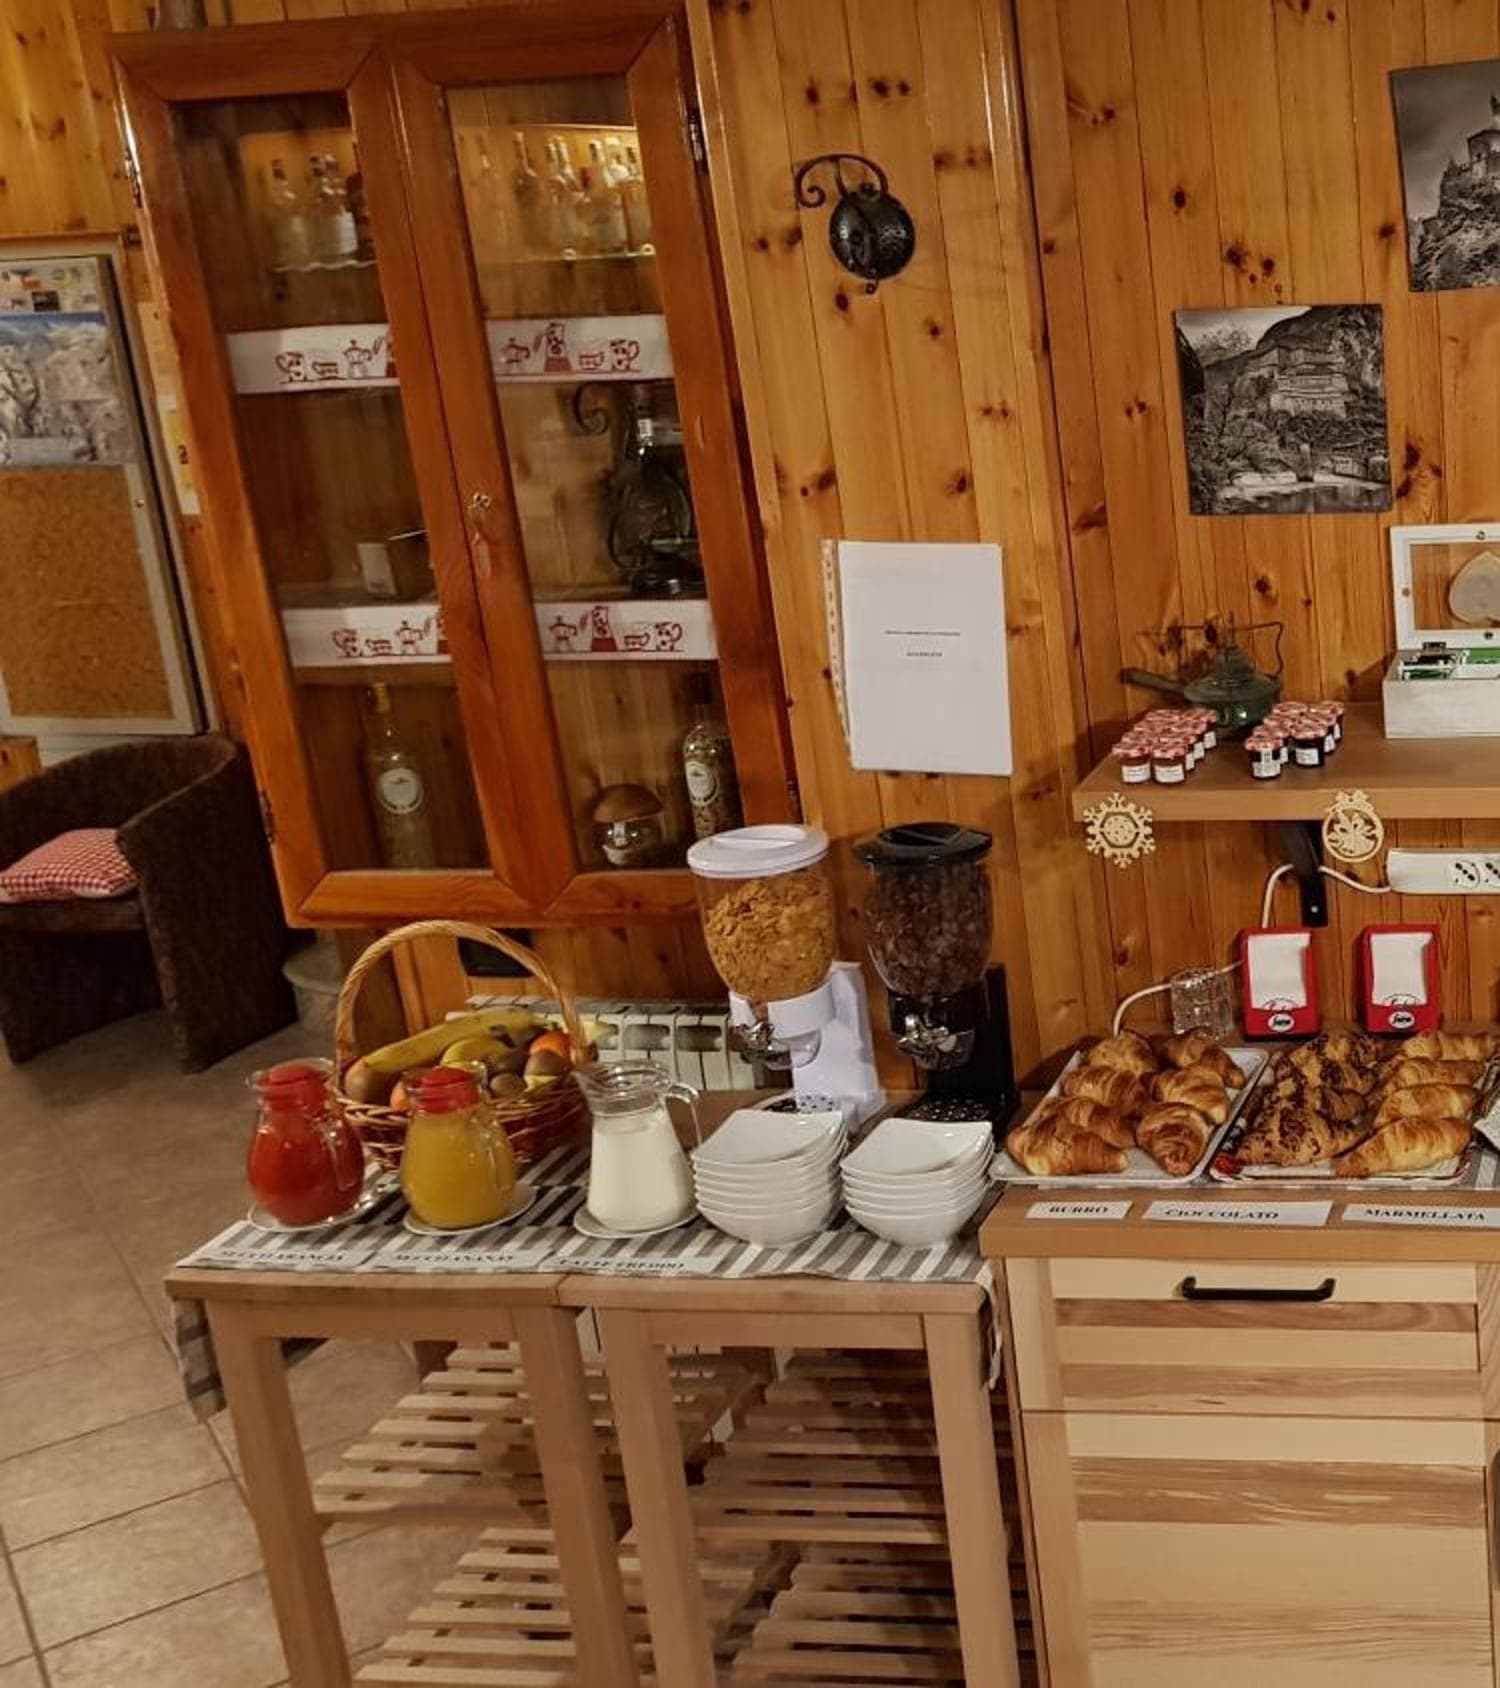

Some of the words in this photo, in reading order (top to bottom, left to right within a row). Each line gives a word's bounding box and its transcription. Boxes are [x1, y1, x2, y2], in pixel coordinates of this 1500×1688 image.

[1049, 1205, 1109, 1215] BURRO
[1165, 1207, 1281, 1220] CIOCCOLATO
[1364, 1208, 1487, 1221] MARMELLATA
